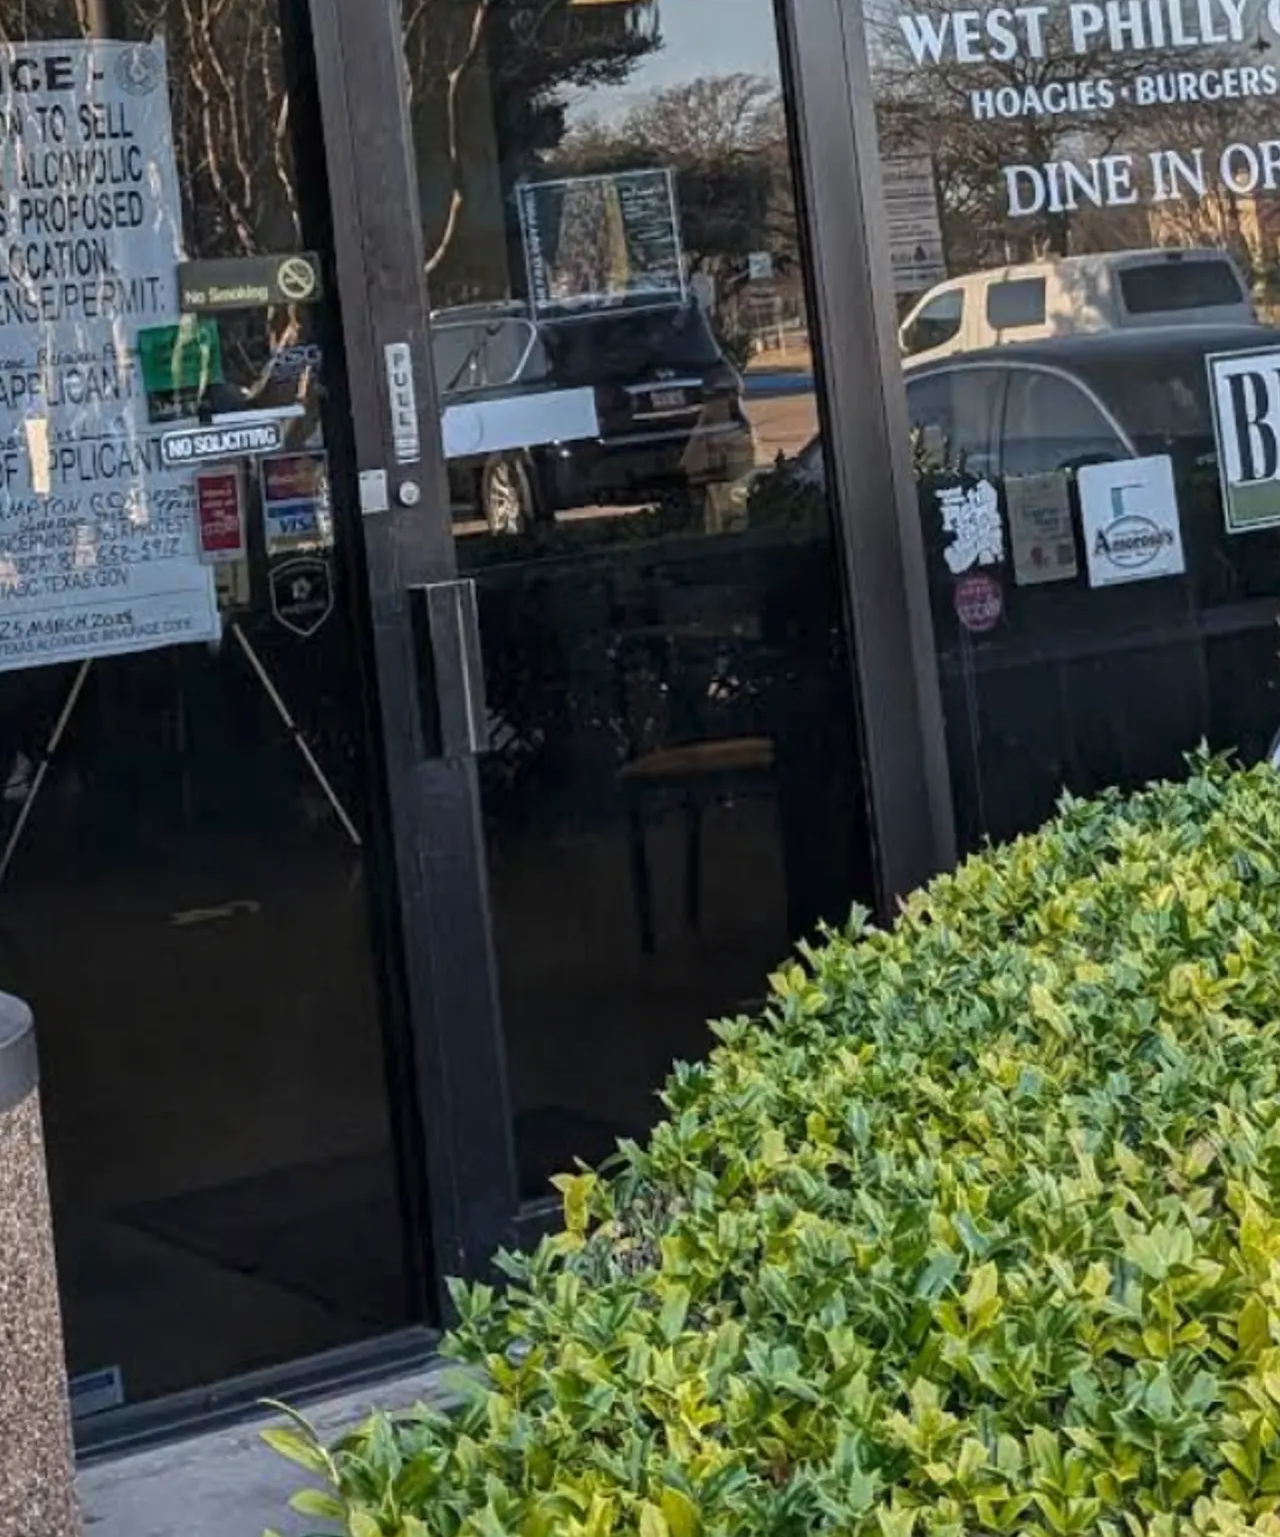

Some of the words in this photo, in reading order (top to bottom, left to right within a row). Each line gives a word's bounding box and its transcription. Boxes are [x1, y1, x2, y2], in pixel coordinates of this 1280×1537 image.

[898, 5, 1048, 64] WEST
[972, 79, 1114, 119] HOAGIES
[1135, 66, 1278, 106] BURGERS
[36, 104, 66, 144] TO
[79, 102, 133, 141] SELL
[22, 145, 143, 190] ALCOHOLIC
[1004, 156, 1137, 216] DINE
[1151, 149, 1206, 202] IN
[21, 191, 143, 235] PROPOSED
[185, 290, 206, 305] No
[208, 285, 269, 303] Smoking
[392, 352, 412, 428] PULL
[36, 435, 167, 485] PPLICANT
[168, 439, 192, 457] NO
